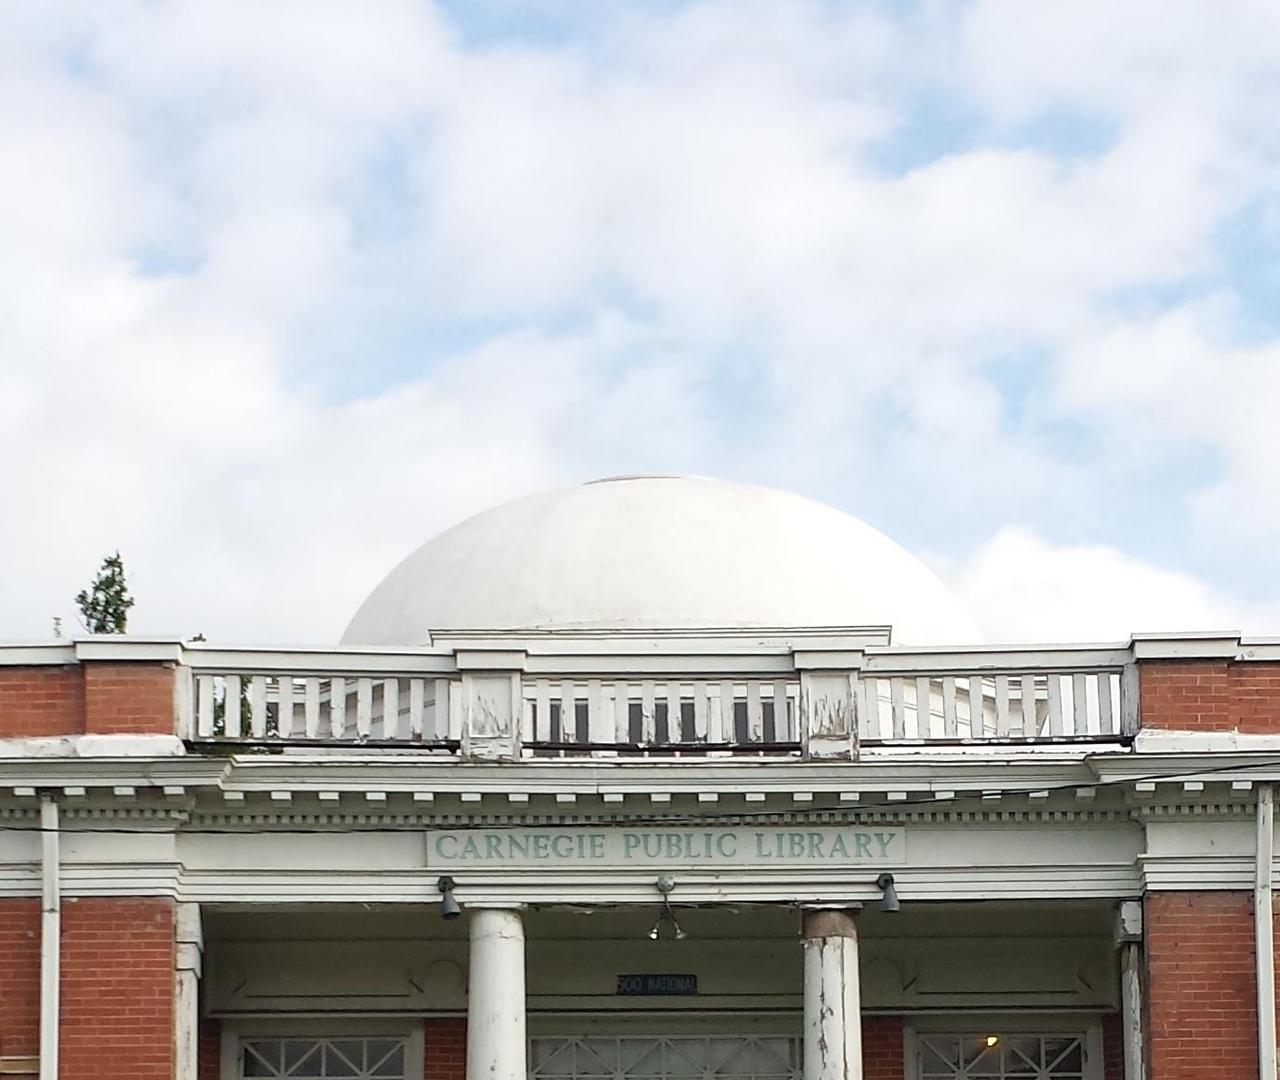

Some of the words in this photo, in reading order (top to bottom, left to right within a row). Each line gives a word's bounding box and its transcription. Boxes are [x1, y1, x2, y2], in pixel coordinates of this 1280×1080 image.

[434, 833, 606, 861] CARNEGIE
[623, 832, 738, 860] PUBLIC
[754, 831, 897, 859] LIBRARY
[617, 977, 642, 992] 500
